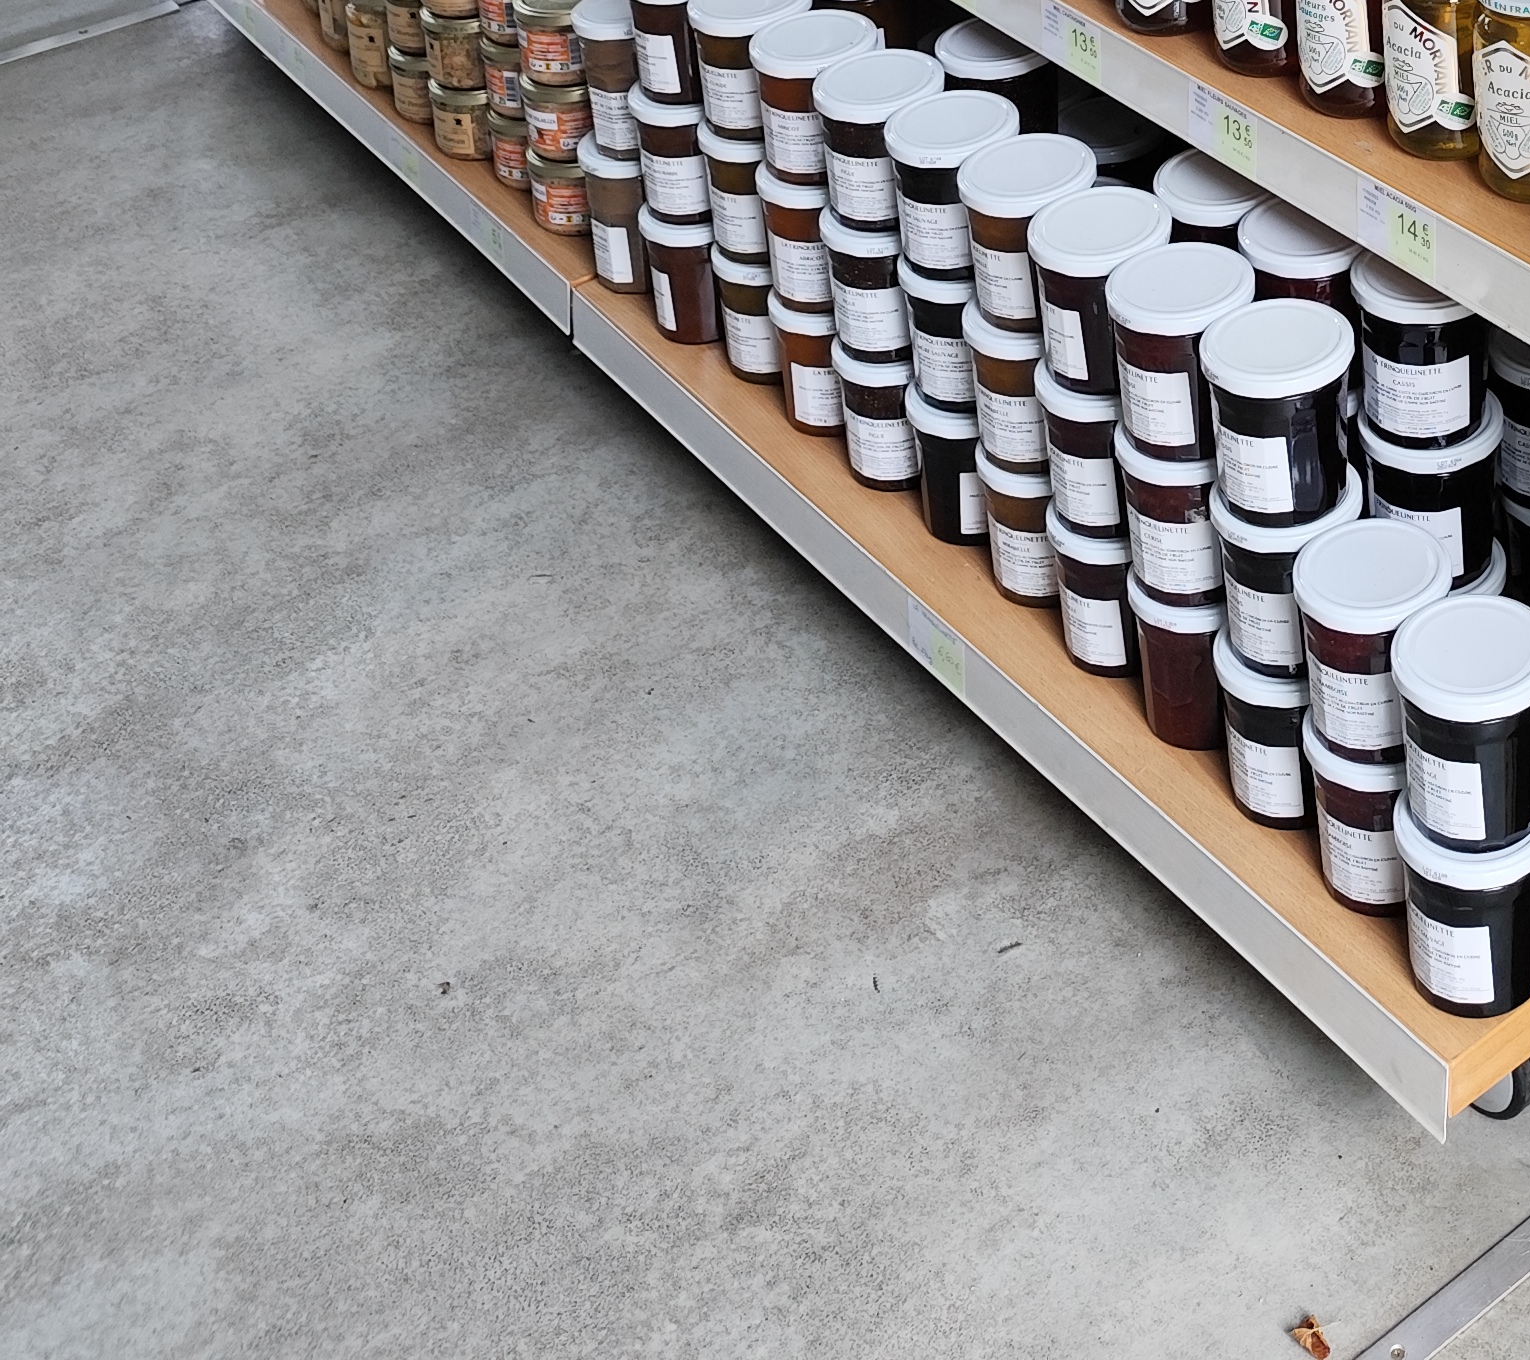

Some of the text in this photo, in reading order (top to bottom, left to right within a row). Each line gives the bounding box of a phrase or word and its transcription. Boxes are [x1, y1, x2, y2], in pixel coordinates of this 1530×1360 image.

[1071, 28, 1088, 53] 13
[1385, 38, 1422, 60] Acacia
[1409, 25, 1448, 96] MORVAN
[1223, 114, 1242, 141] 13
[1499, 114, 1521, 126] MIEL
[1397, 212, 1431, 250] 14 30
